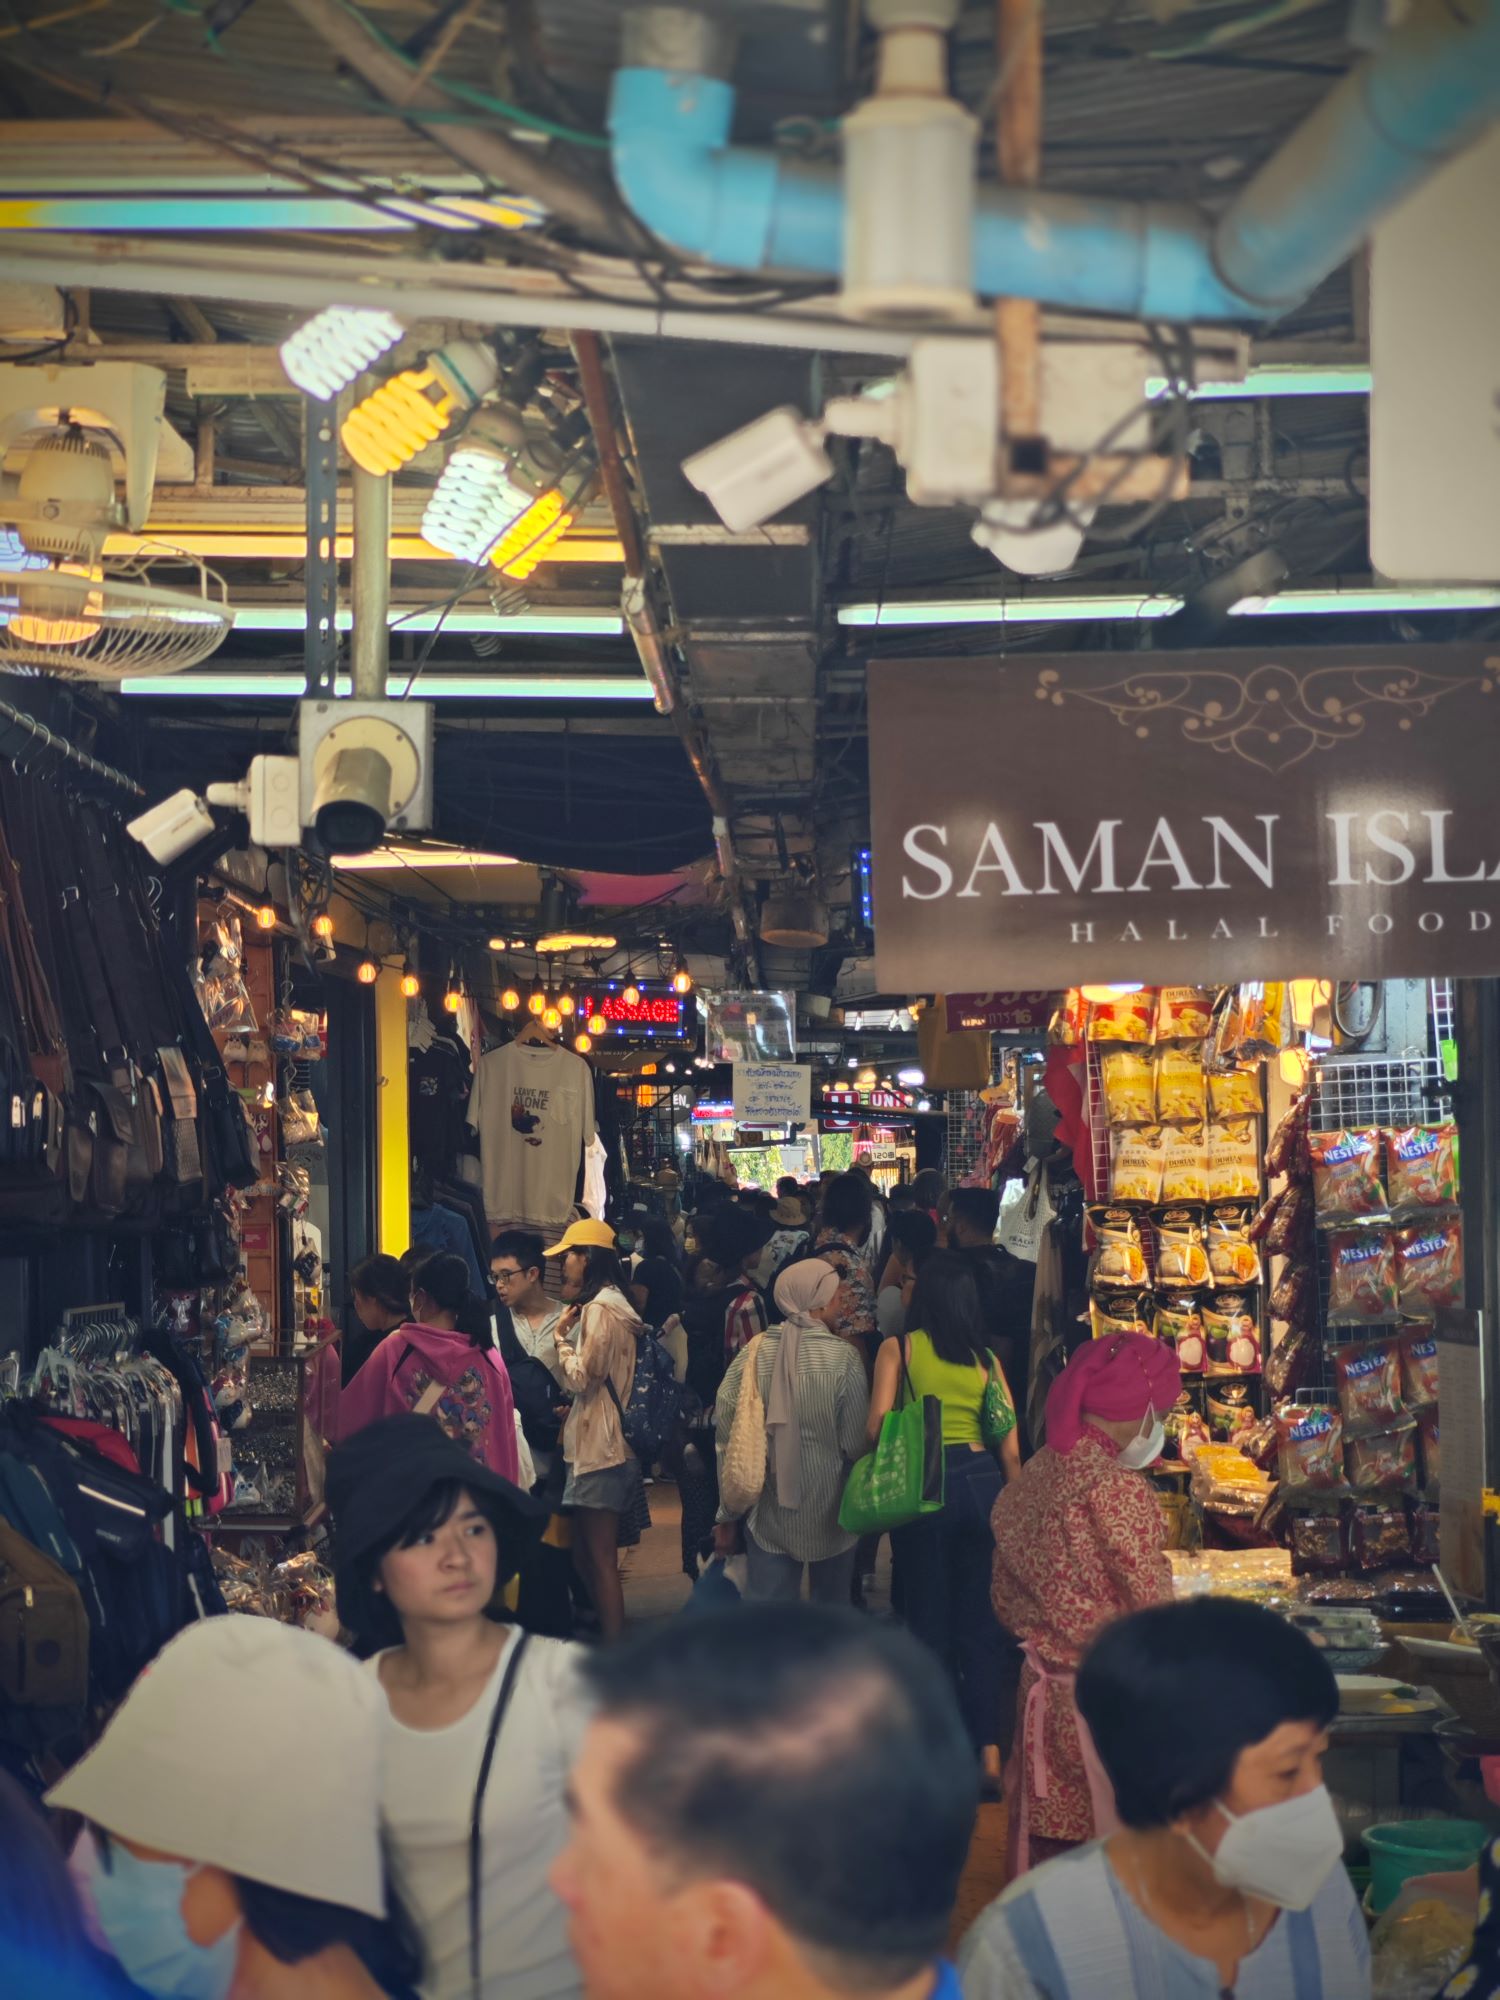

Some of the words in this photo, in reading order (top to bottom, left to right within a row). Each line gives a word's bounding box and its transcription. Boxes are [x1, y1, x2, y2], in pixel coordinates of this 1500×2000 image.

[903, 815, 1280, 899] SAMAN
[1071, 917, 1278, 942] HALAL
[1326, 911, 1491, 935] FOOD
[514, 1087, 536, 1096] LEAVE
[539, 1090, 550, 1098] ME
[514, 1096, 548, 1110] ALONE
[1324, 1145, 1366, 1163] NESTE
[1400, 1143, 1440, 1158] NESTEA
[1341, 1246, 1383, 1259] NESTEA
[1345, 1355, 1387, 1376] NESTEA
[1290, 1422, 1332, 1437] NESTEA
